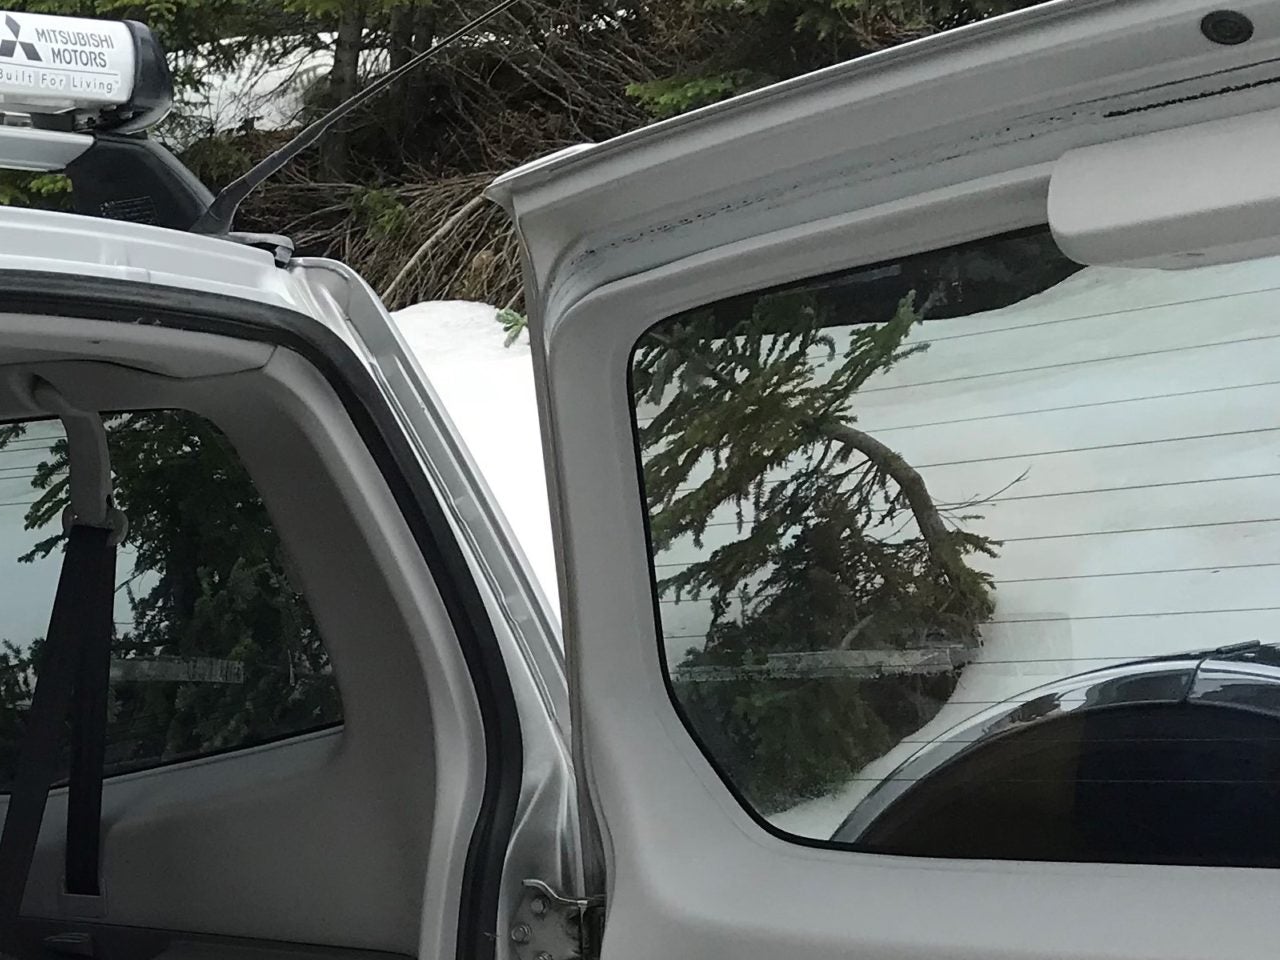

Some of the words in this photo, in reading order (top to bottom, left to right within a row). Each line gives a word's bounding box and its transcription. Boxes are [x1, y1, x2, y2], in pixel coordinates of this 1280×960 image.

[35, 28, 114, 49] MITSUBISHI
[51, 48, 107, 68] MOTORS
[41, 74, 64, 86] For
